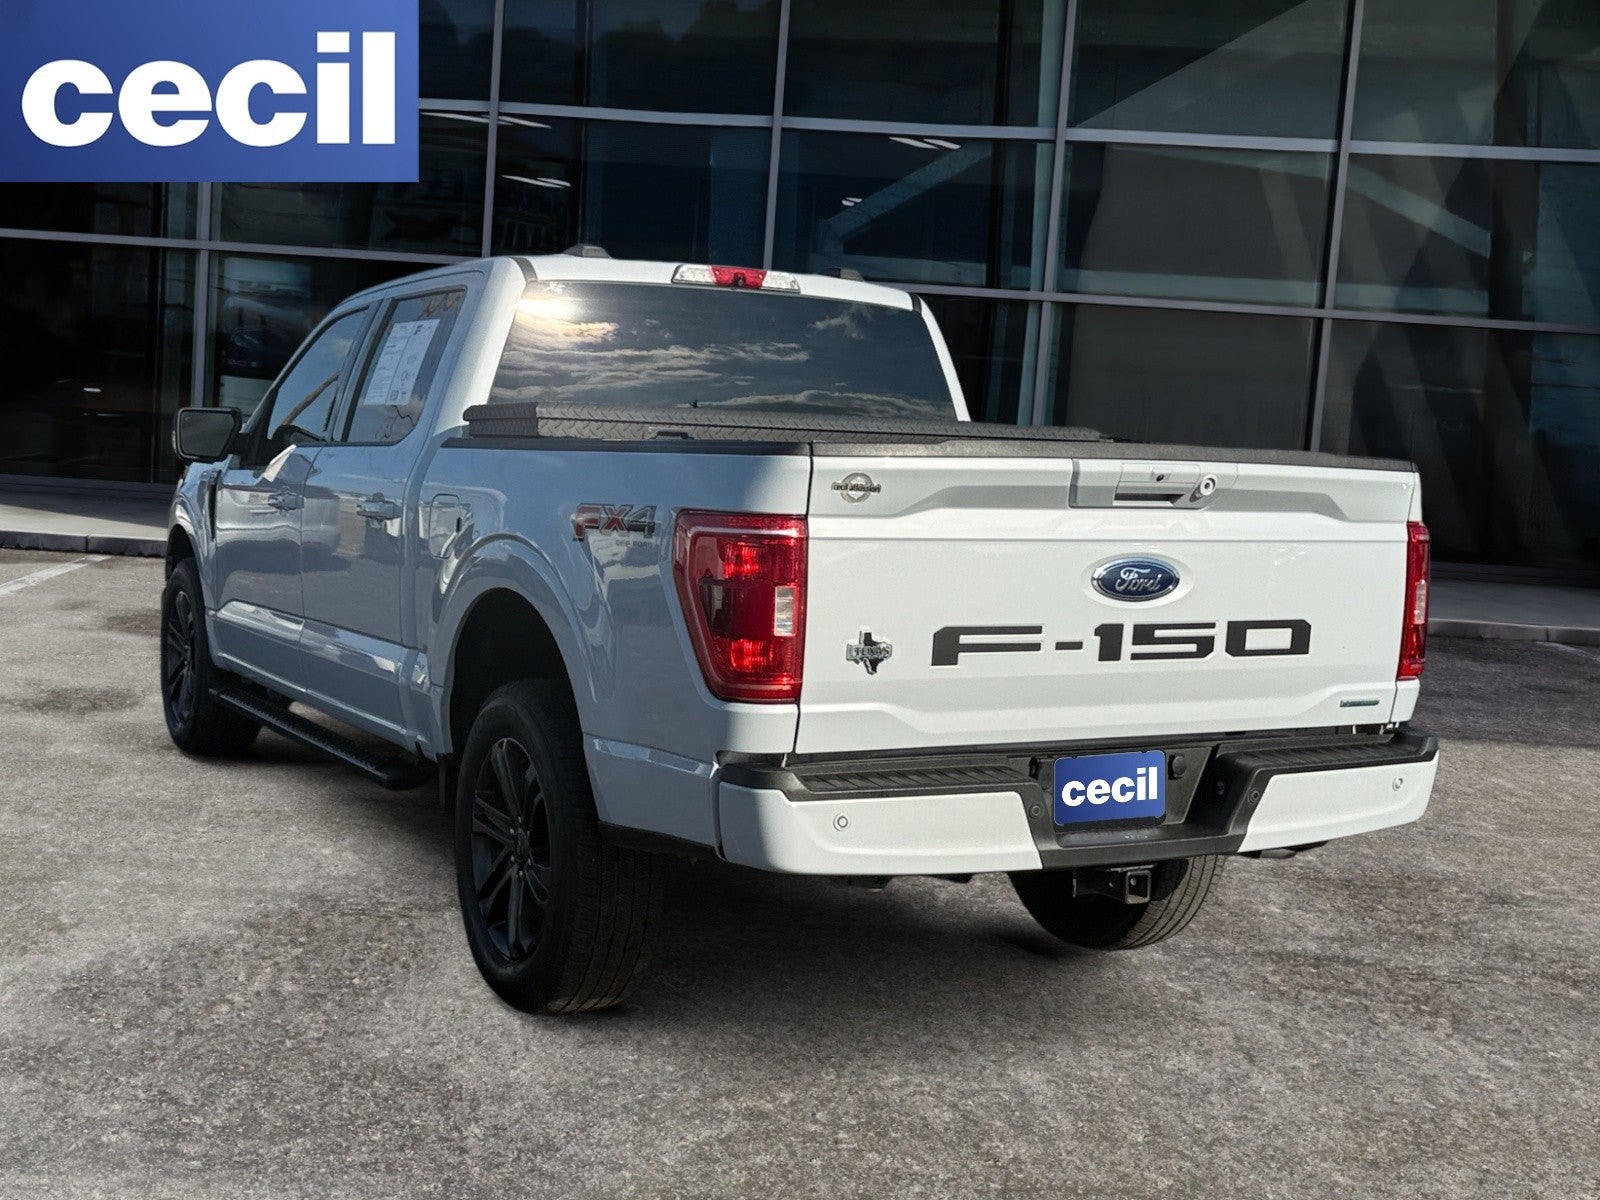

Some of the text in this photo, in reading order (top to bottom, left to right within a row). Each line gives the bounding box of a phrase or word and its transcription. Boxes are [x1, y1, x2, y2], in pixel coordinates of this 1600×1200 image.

[571, 503, 657, 542] FX4
[1115, 566, 1162, 591] Ford
[854, 645, 890, 657] TEXAS
[931, 619, 1312, 666] F-150
[1061, 766, 1158, 807] cecil
